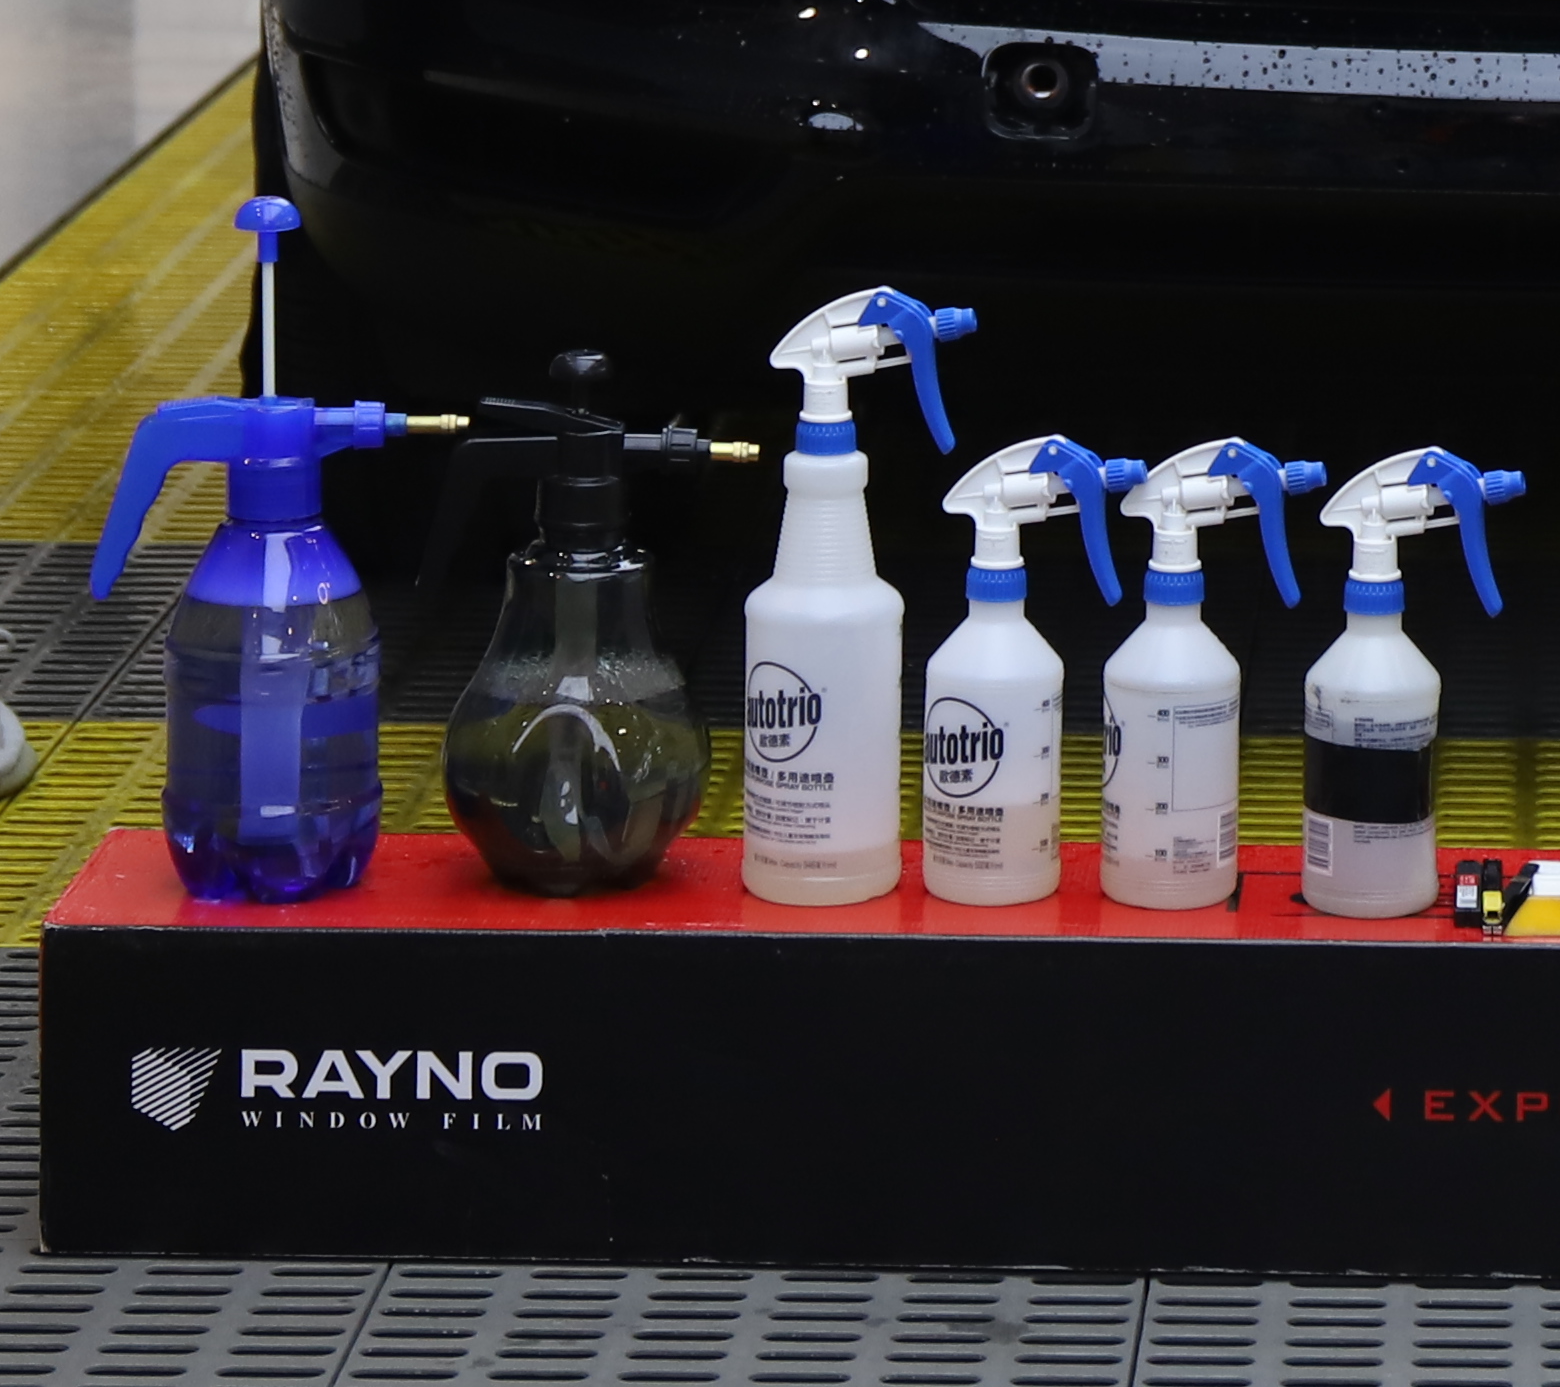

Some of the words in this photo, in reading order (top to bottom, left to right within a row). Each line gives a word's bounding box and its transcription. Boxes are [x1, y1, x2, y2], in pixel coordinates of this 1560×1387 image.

[747, 686, 822, 730] autotrio
[925, 722, 1004, 765] autotrio
[241, 1049, 543, 1101] RAYNO
[241, 1111, 411, 1129] WINDOW
[443, 1112, 542, 1131] FILM
